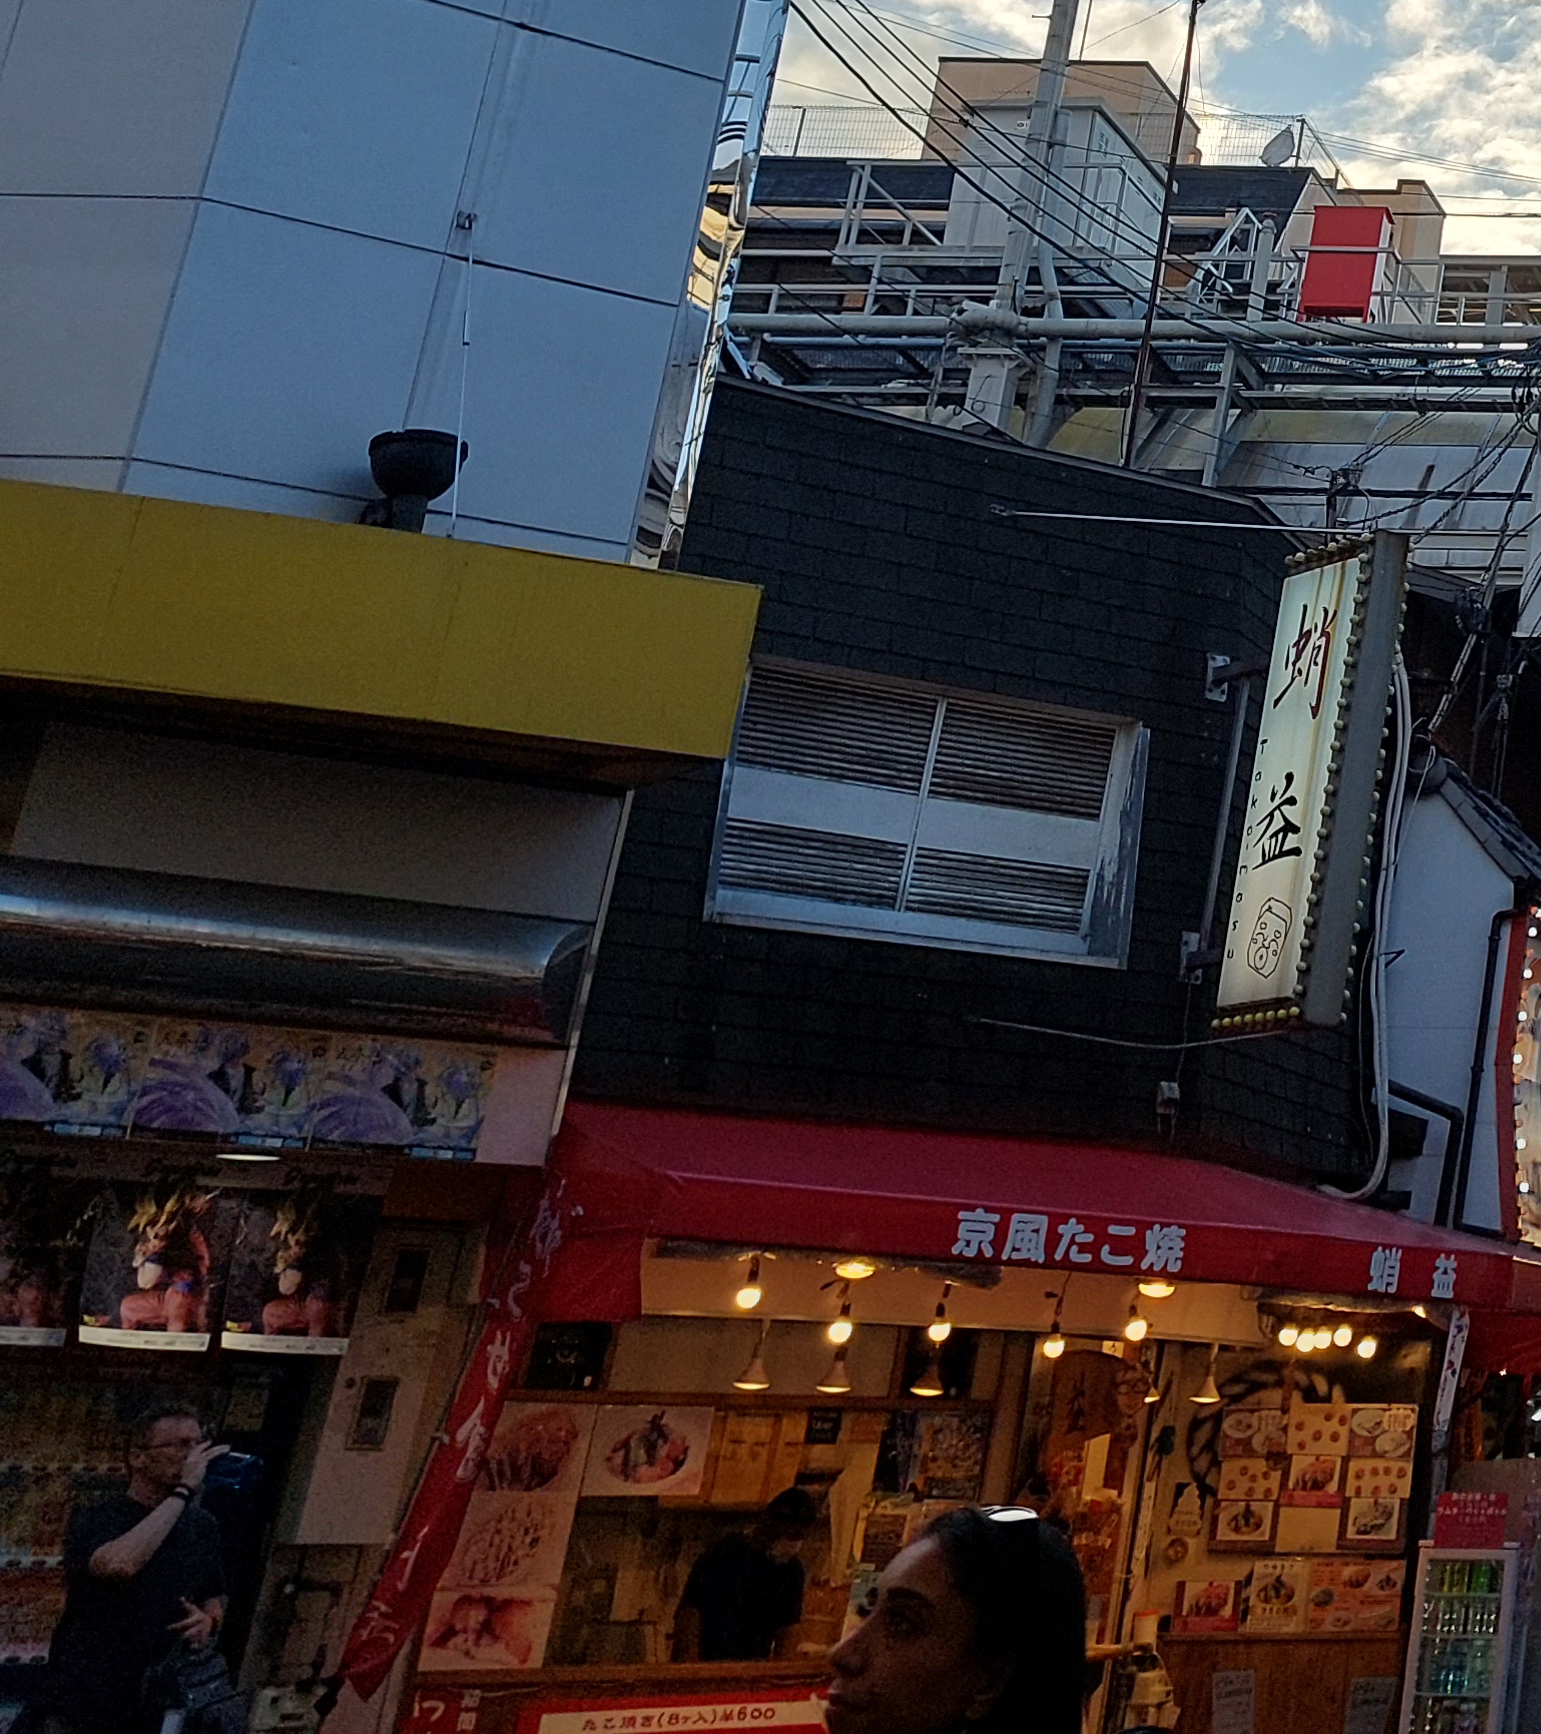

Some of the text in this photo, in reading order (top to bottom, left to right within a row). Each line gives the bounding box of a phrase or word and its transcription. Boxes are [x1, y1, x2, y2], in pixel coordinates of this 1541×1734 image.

[952, 1208, 1186, 1273] 京風たこ焼
